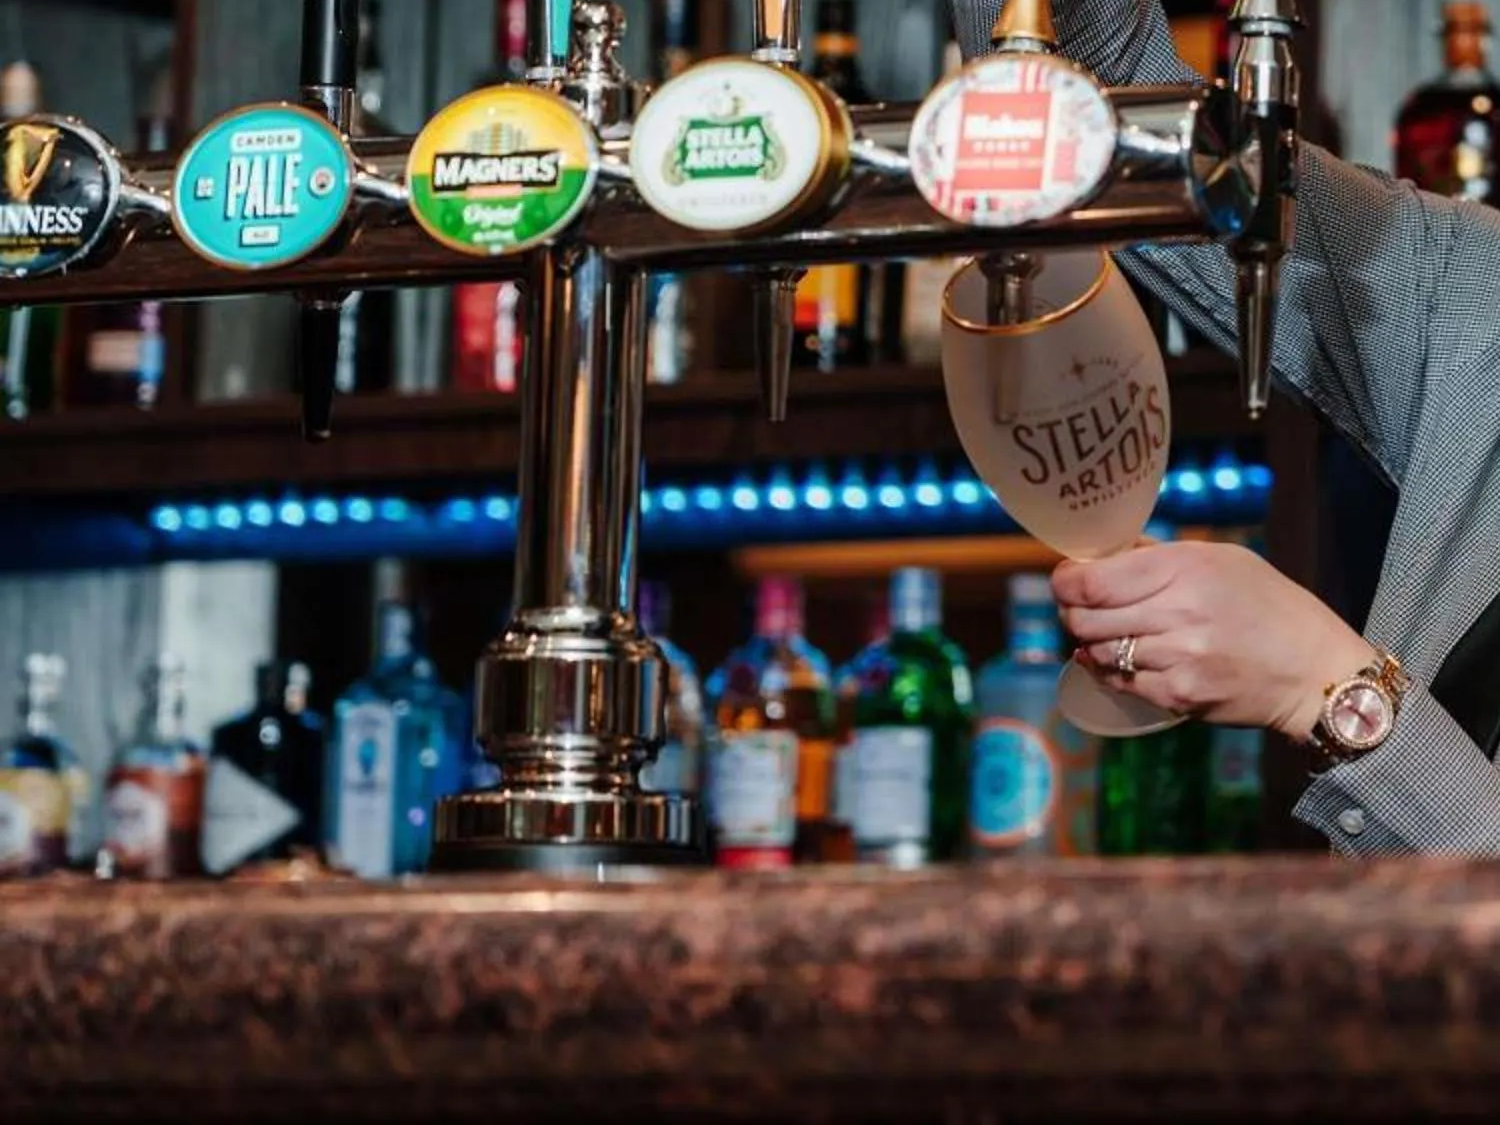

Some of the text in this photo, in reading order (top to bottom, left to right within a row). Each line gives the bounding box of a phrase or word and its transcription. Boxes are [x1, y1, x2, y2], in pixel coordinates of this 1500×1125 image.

[236, 135, 297, 148] CAMDEN
[686, 124, 766, 149] STELLA
[434, 152, 560, 188] MAGNERS
[684, 146, 767, 170] ARTOIS
[225, 153, 304, 220] PALE
[1012, 380, 1141, 486] STELLA
[1059, 385, 1167, 500] ARTOIS
